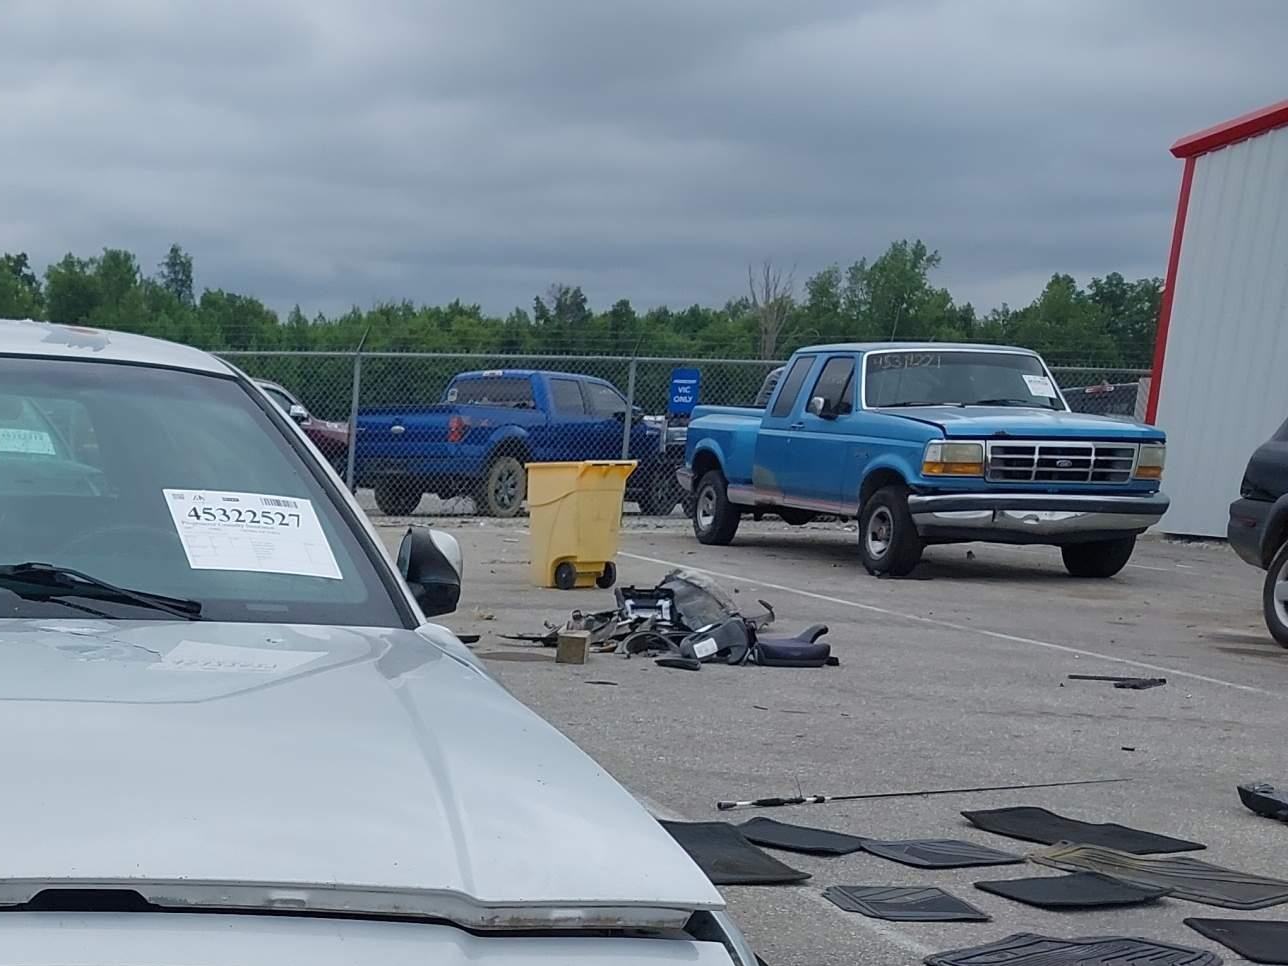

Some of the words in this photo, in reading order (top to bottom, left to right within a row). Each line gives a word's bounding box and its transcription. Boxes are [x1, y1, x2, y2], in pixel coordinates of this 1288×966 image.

[678, 386, 691, 394] VIC
[673, 395, 694, 403] ONLY
[187, 506, 300, 528] 45322527
